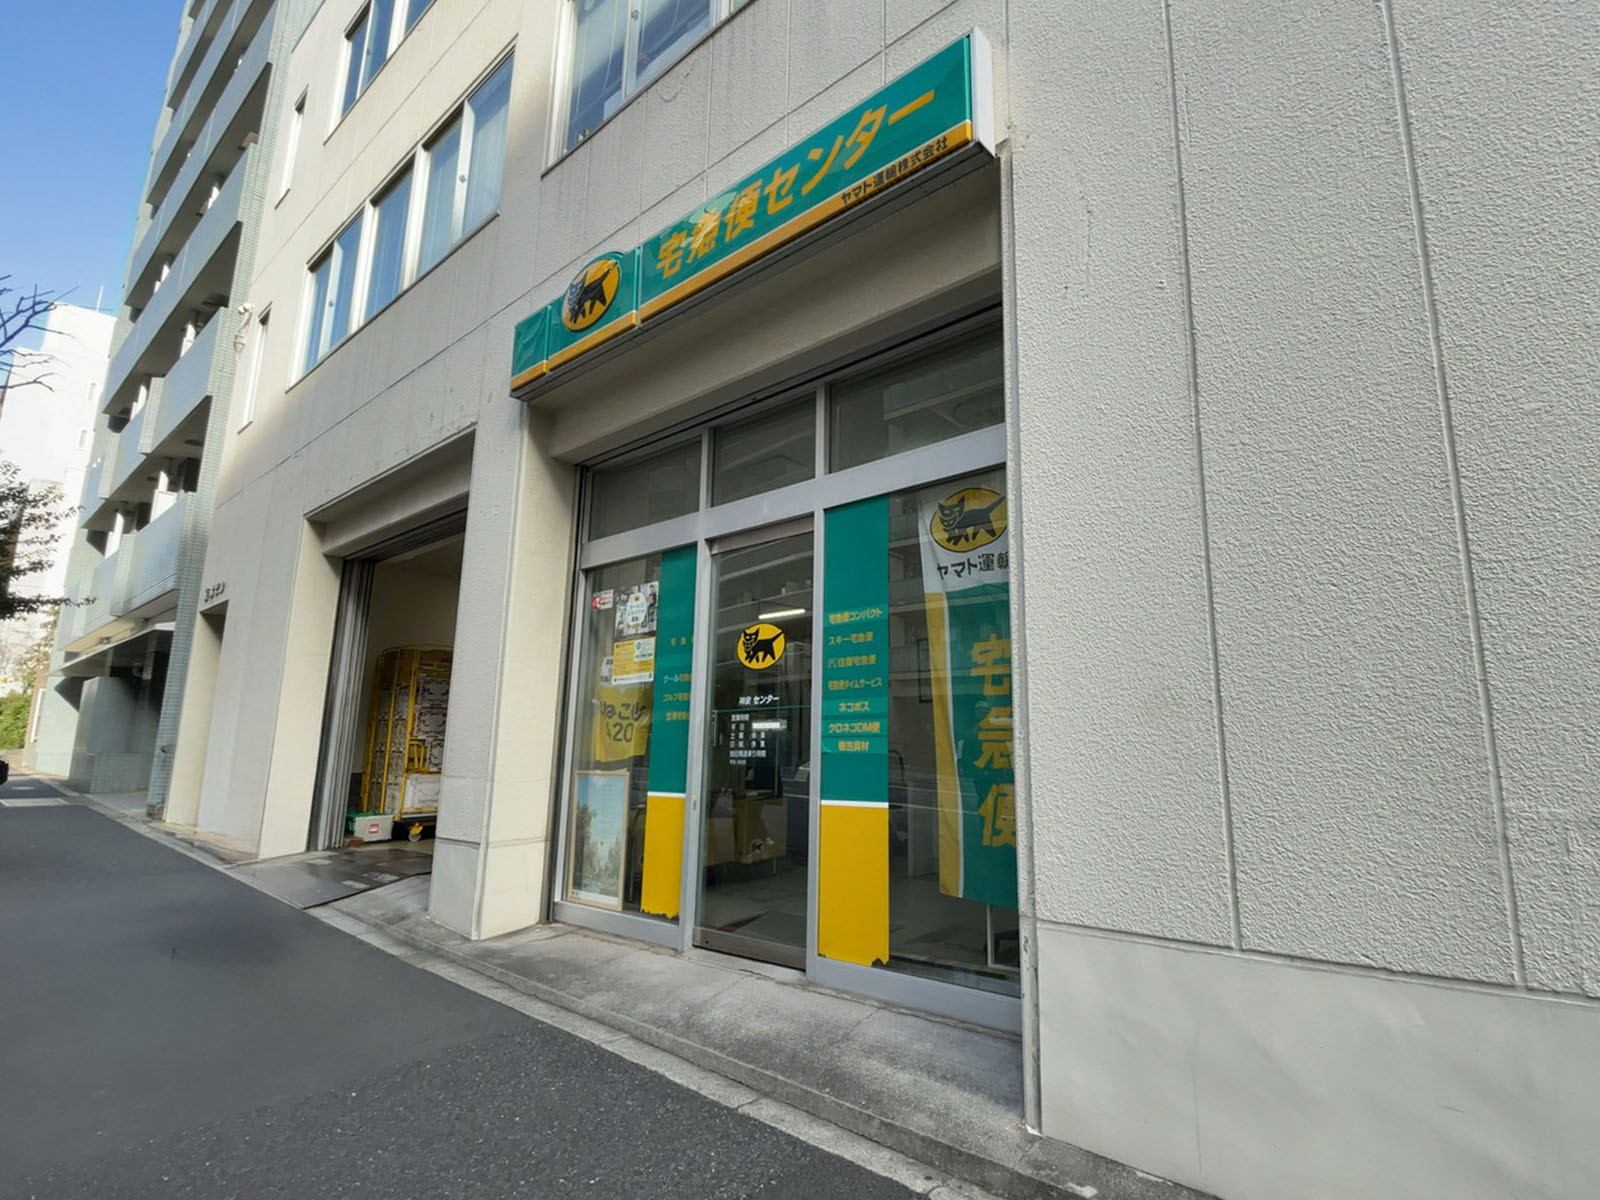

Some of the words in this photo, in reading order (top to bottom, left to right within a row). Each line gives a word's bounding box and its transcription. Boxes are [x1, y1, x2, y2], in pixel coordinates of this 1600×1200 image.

[841, 134, 948, 204] ヤマト運輸株式会社
[656, 89, 936, 280] 宅急便センター
[829, 608, 883, 625] 宅急便コンパクト
[828, 631, 874, 646] スキー宅急便
[828, 677, 883, 690] 宅急便タイムサービス
[753, 694, 780, 705] センター
[838, 701, 870, 712] ネコポス
[828, 721, 881, 734] クロネコDM便
